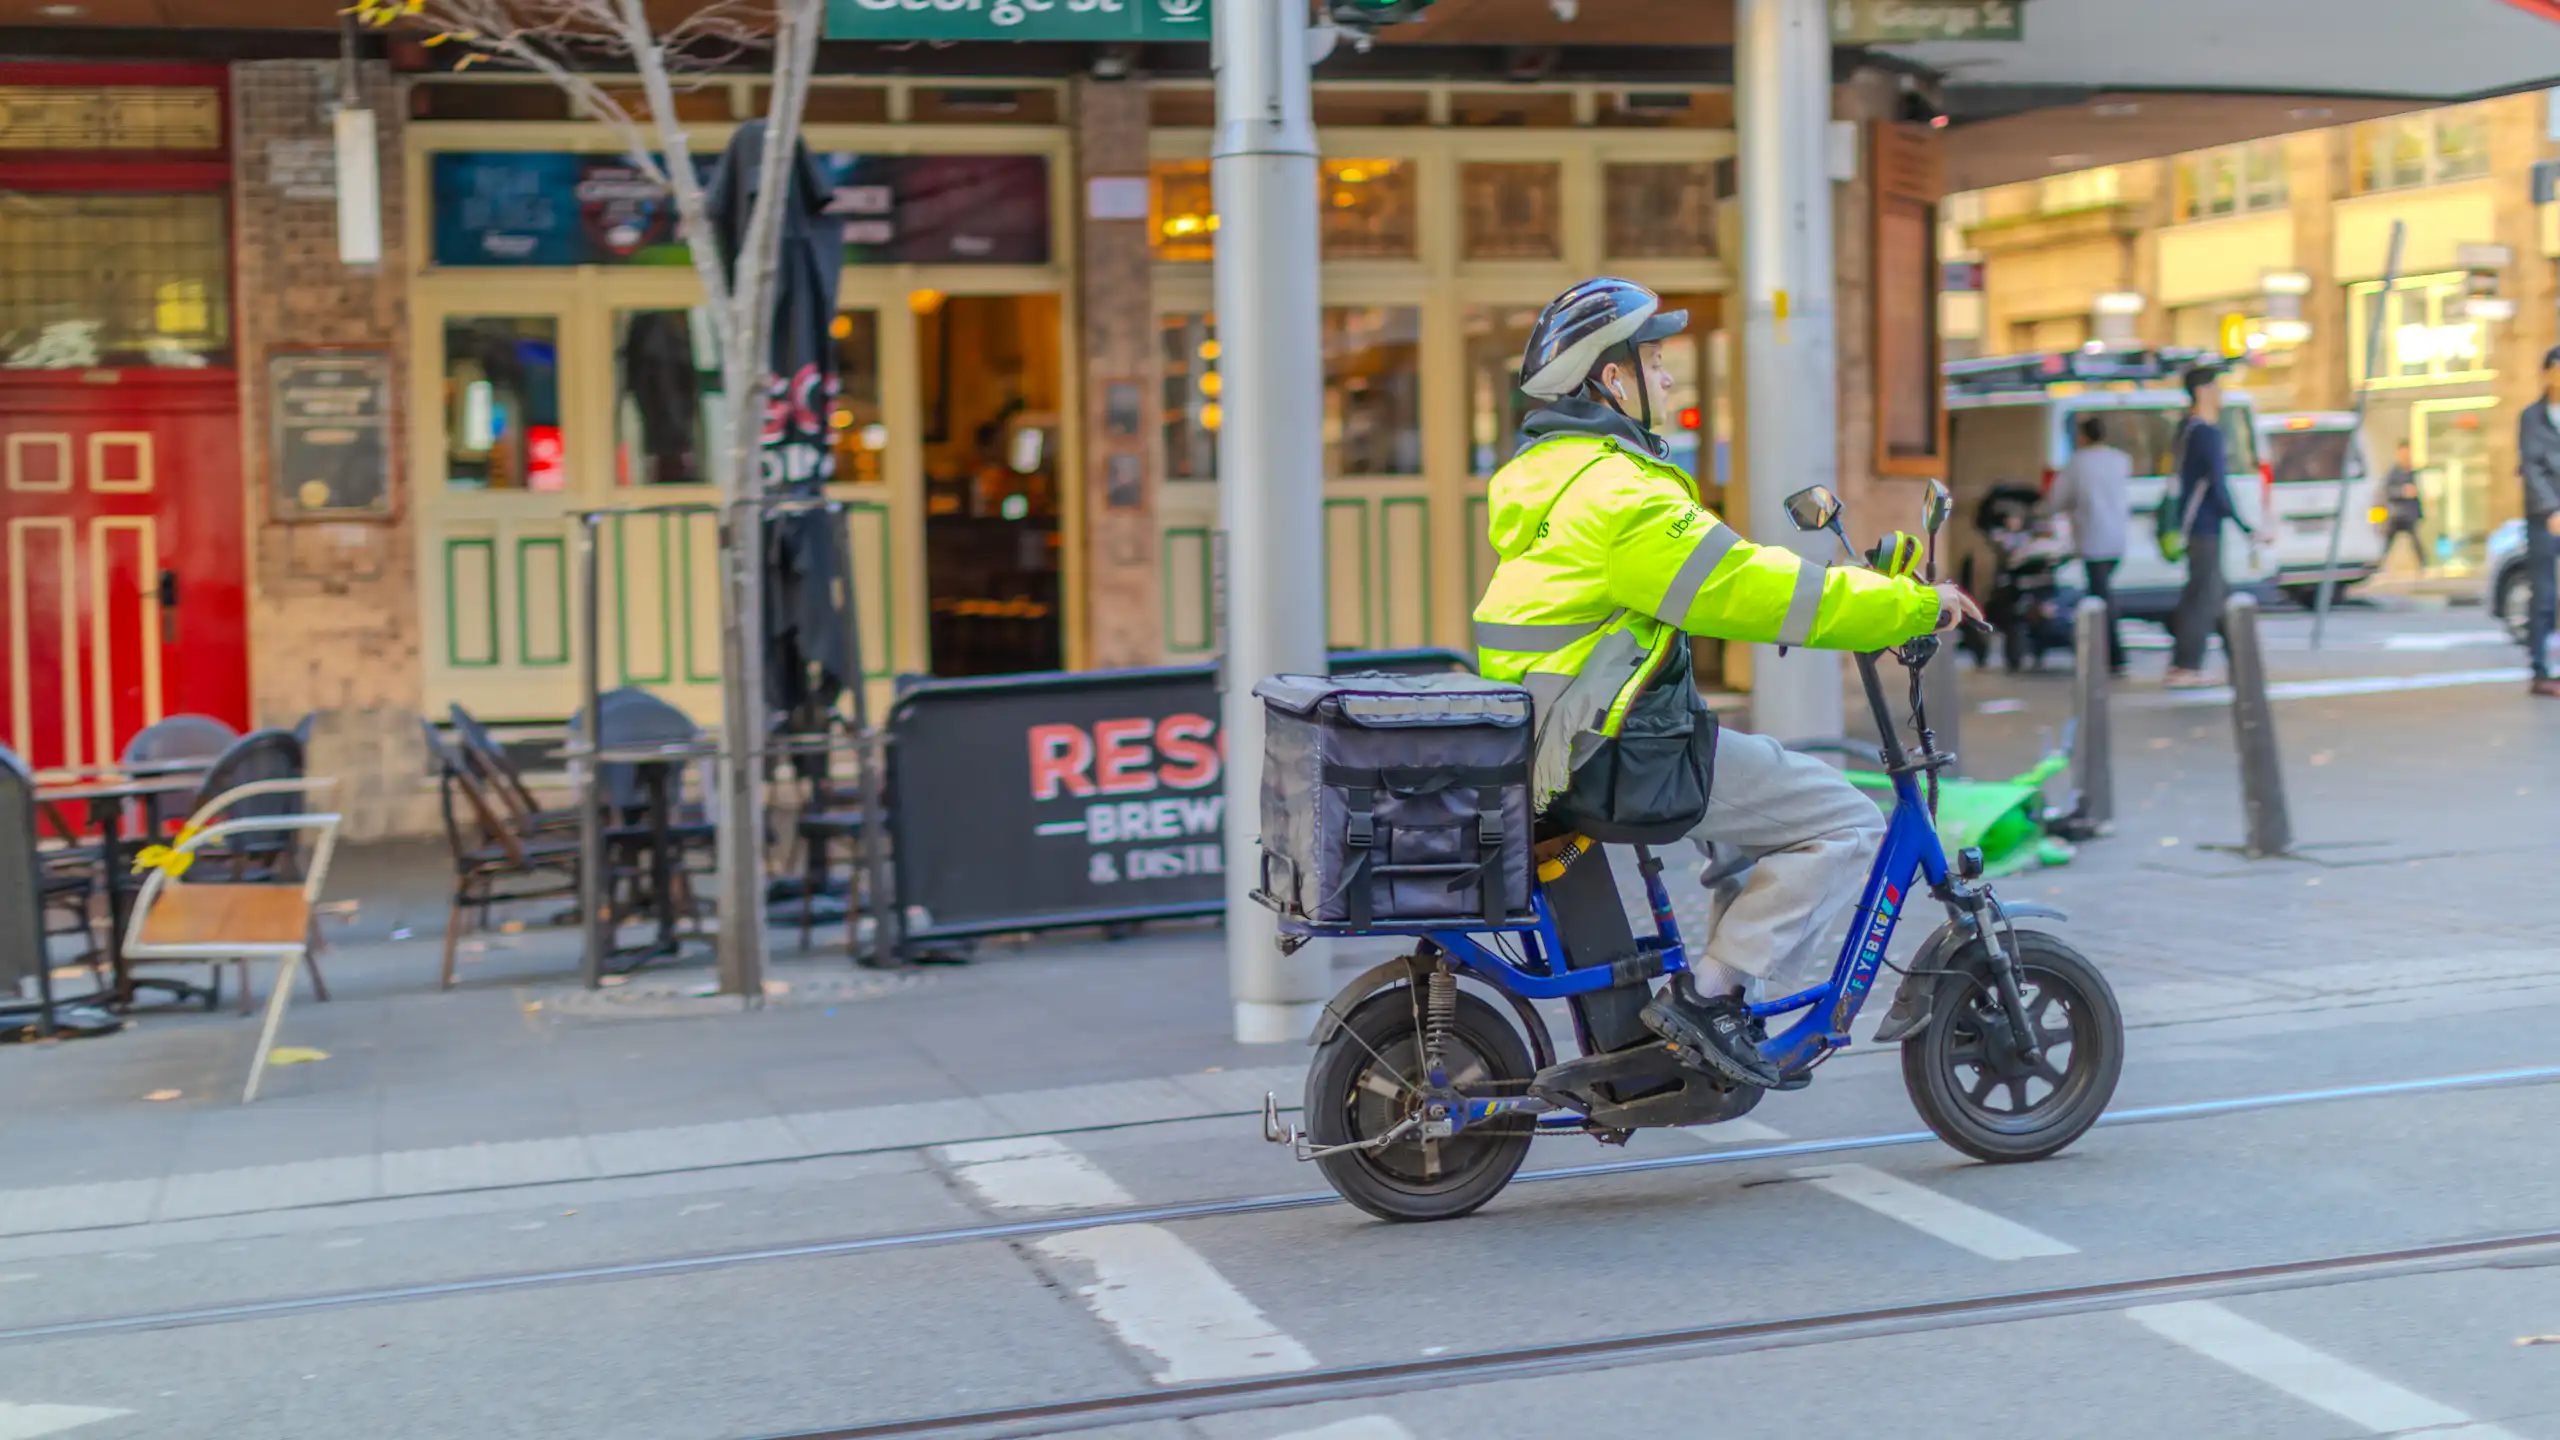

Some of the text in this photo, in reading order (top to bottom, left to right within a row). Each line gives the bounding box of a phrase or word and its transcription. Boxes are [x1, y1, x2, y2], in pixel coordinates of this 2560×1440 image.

[1665, 508, 1697, 539] Uber
[1028, 713, 1229, 801] RES
[1088, 852, 1120, 884] &
[1851, 909, 1890, 990] FLYEBIKE
